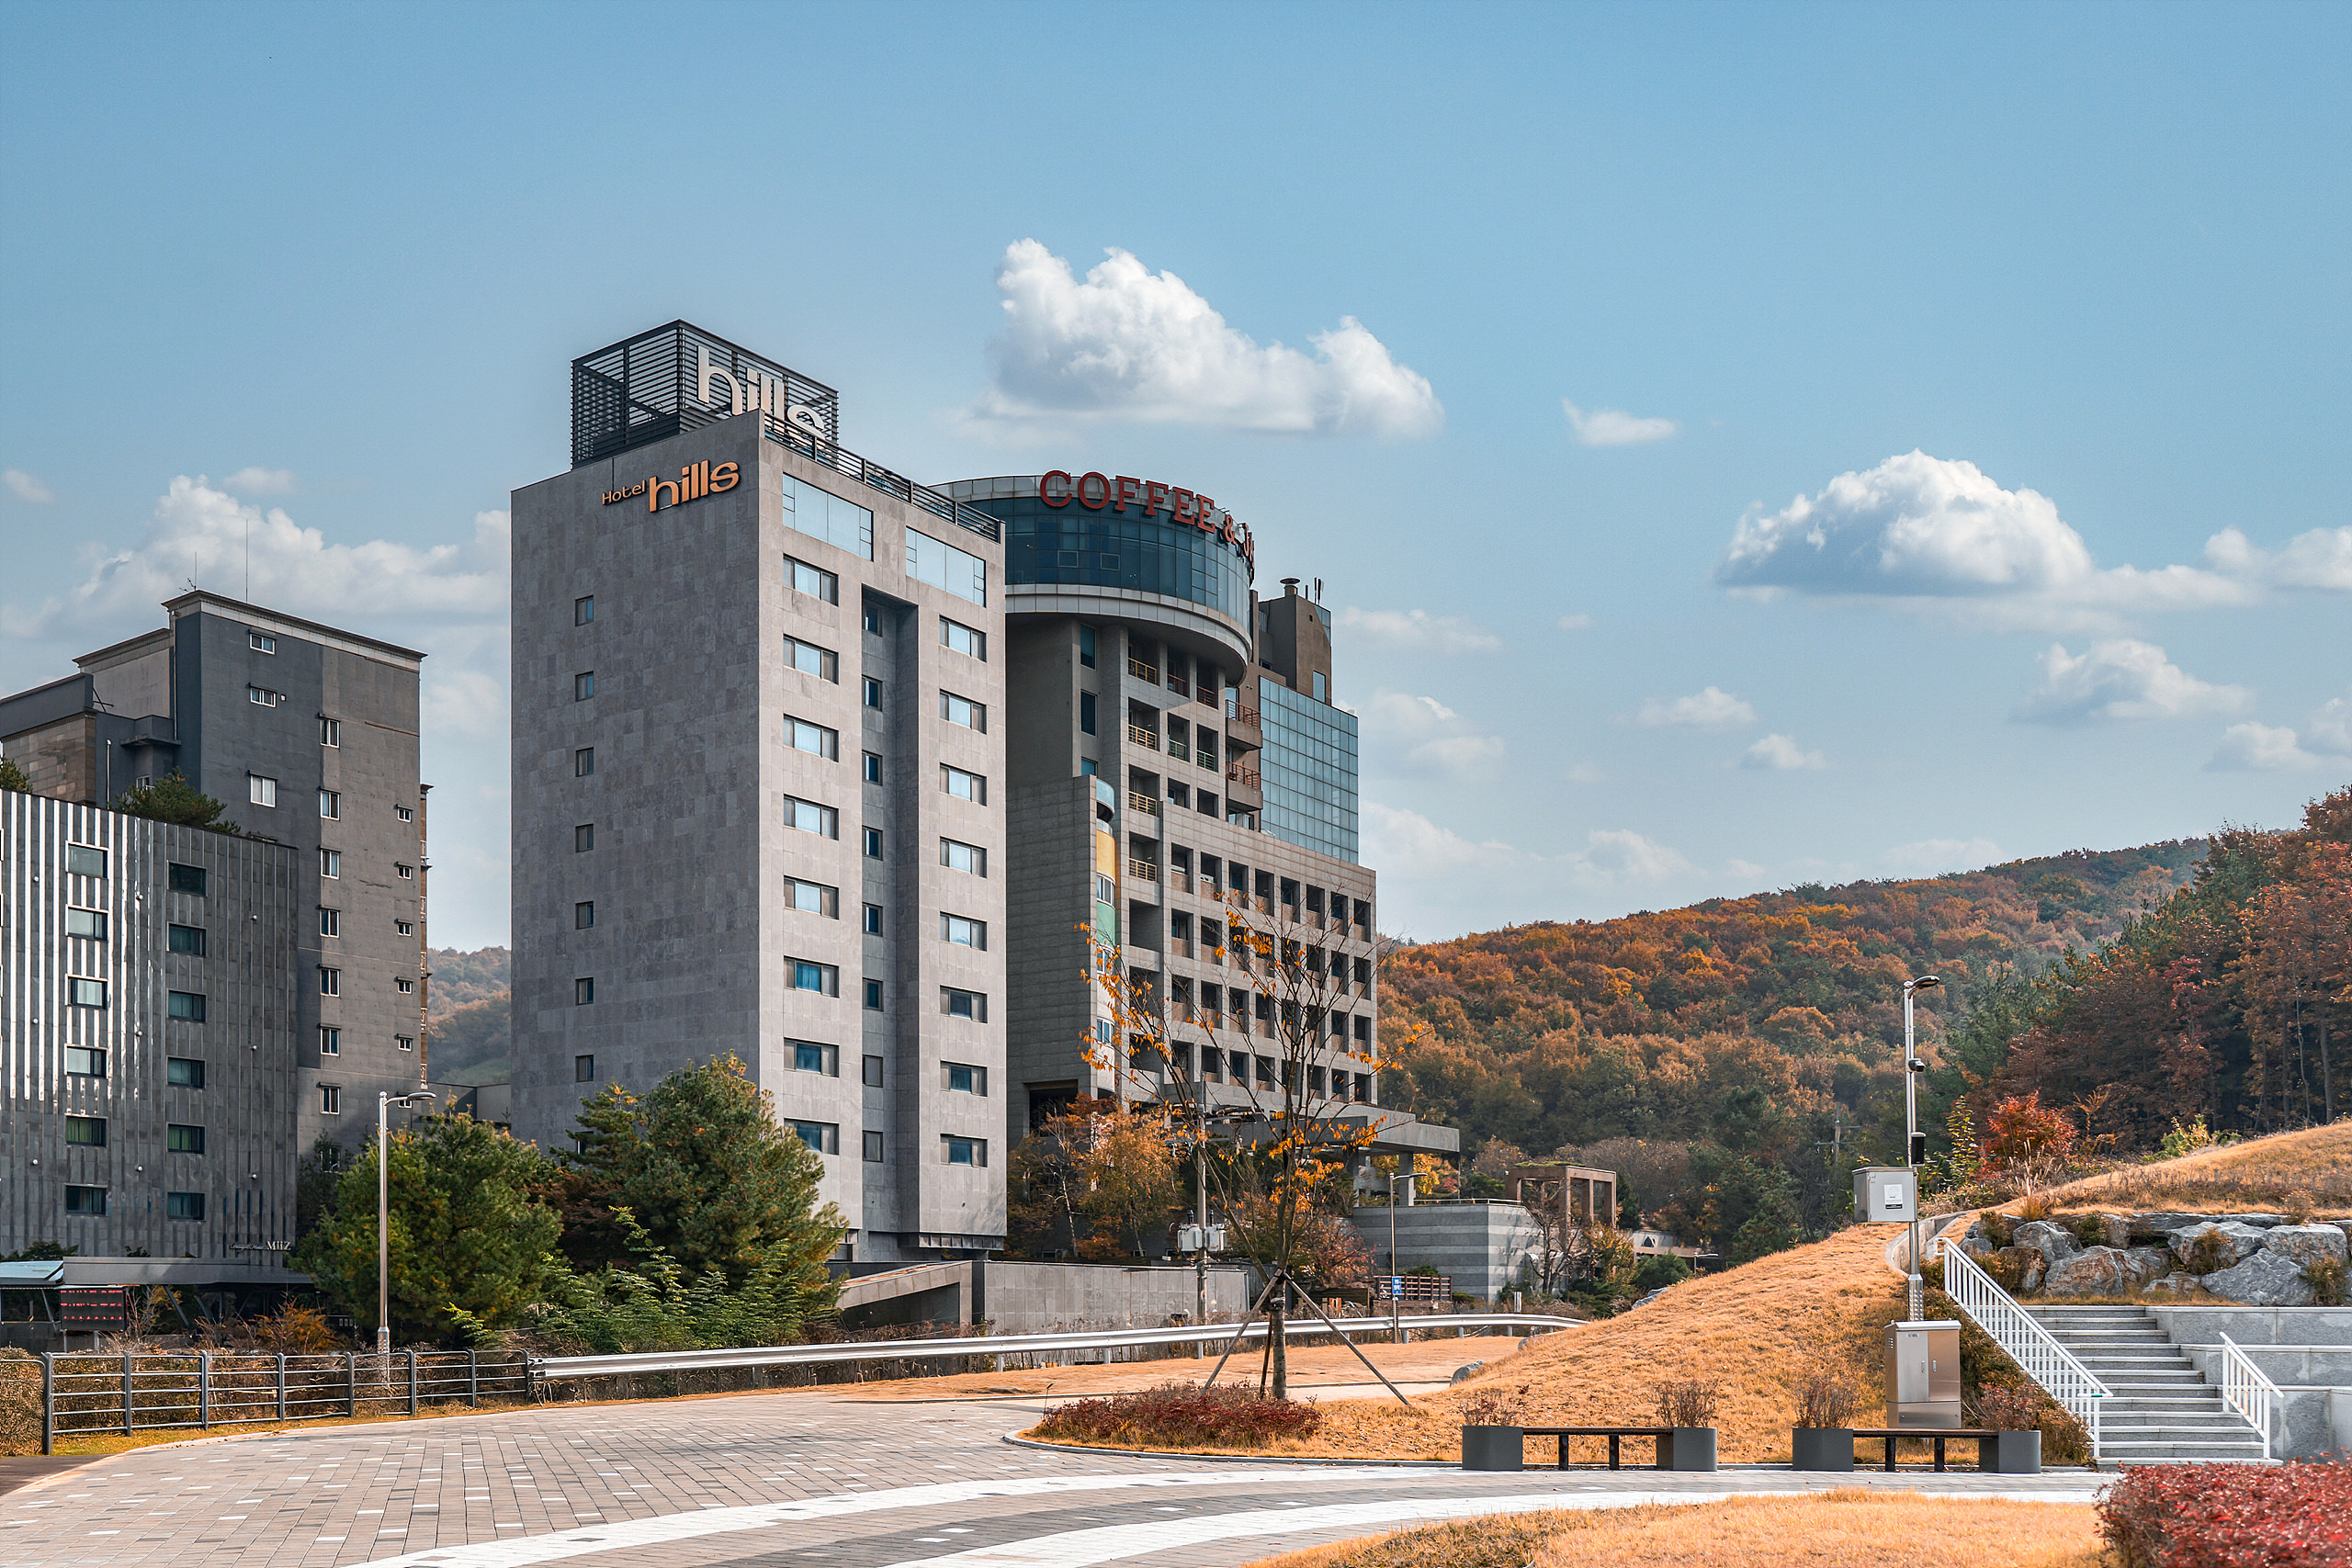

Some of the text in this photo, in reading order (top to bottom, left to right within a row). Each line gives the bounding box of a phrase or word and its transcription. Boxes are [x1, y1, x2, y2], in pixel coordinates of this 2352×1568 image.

[696, 345, 826, 447] hills
[602, 459, 740, 513] Hotel hills
[1039, 469, 1216, 534] COFFEE
[1225, 514, 1238, 545] &
